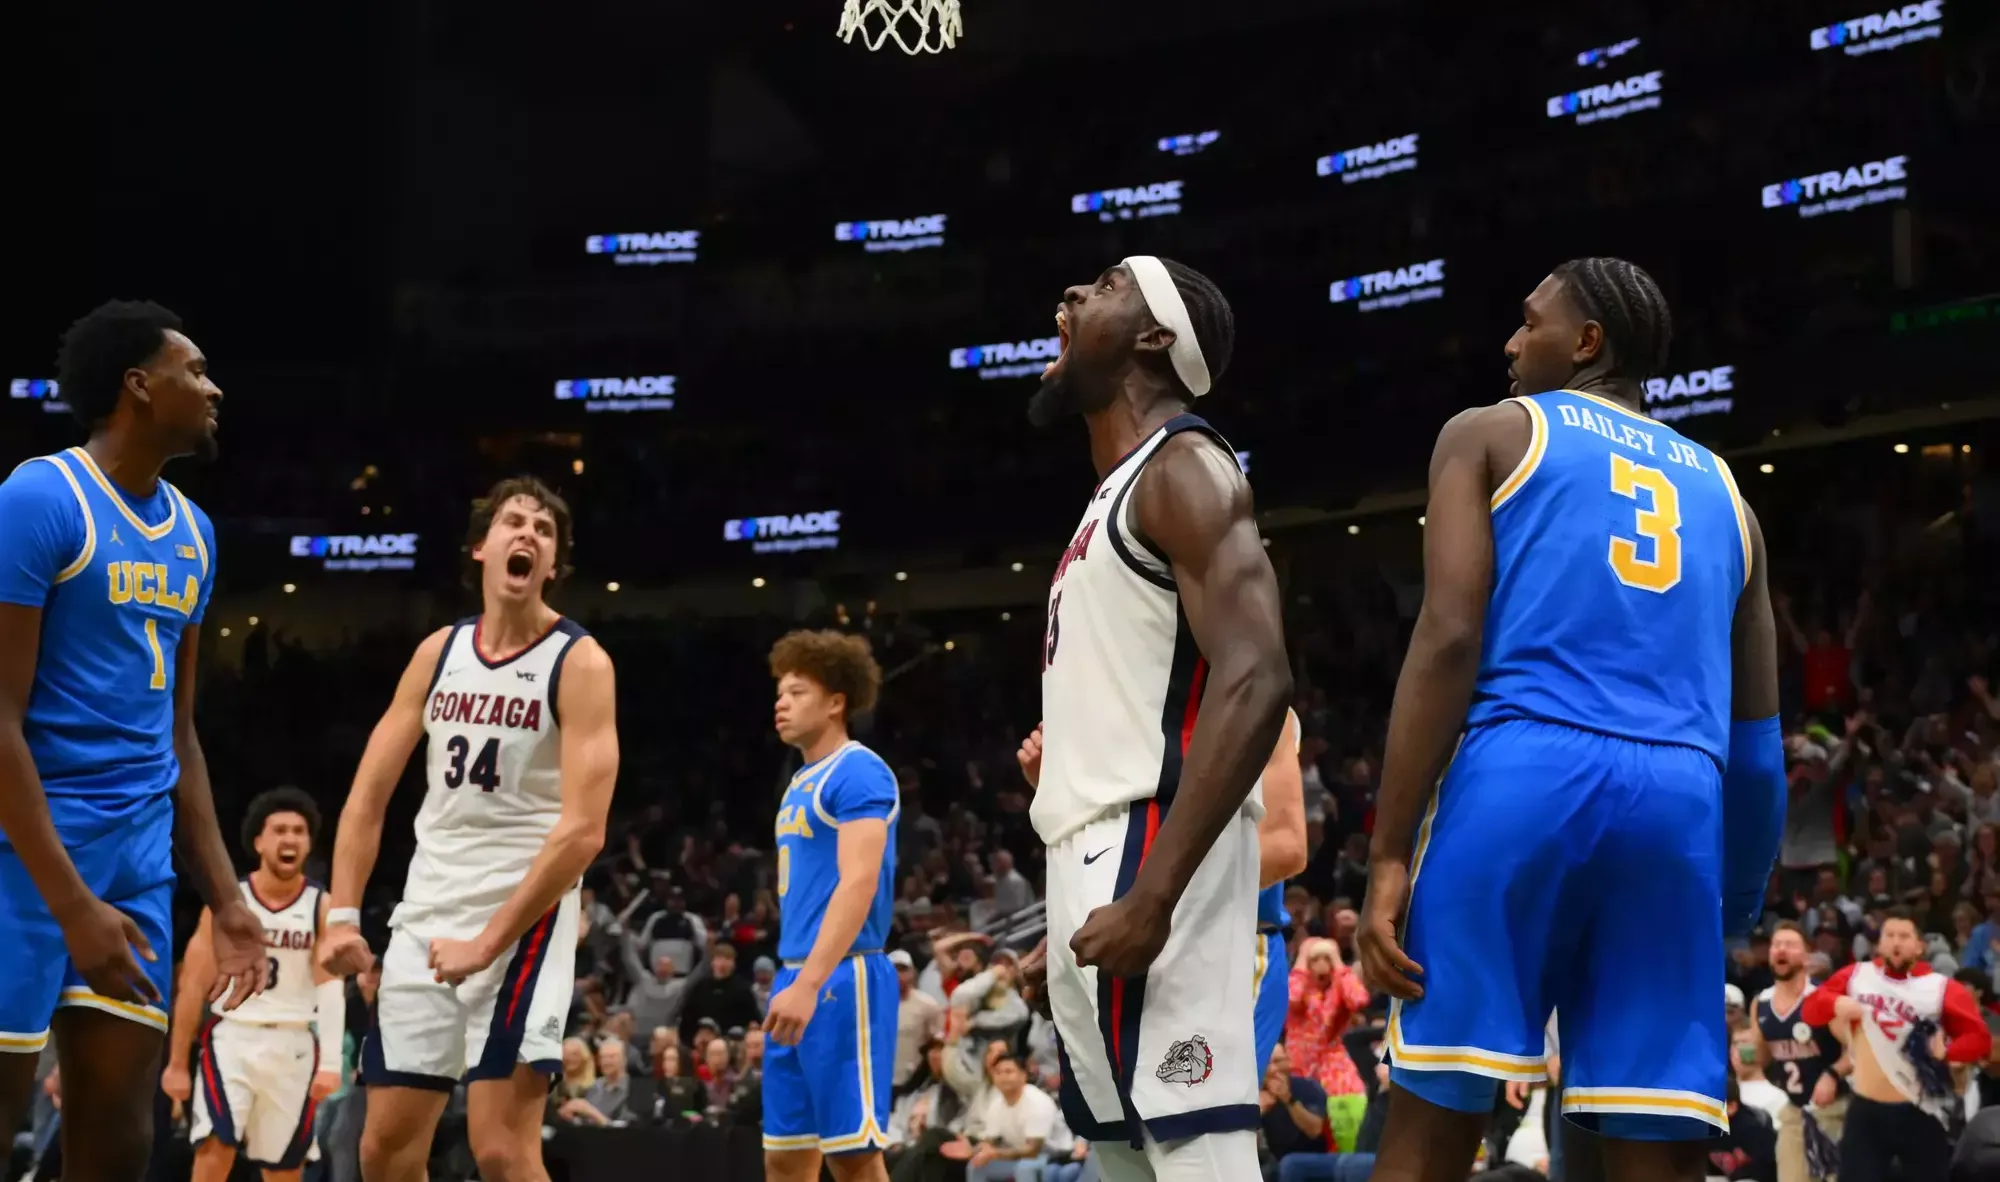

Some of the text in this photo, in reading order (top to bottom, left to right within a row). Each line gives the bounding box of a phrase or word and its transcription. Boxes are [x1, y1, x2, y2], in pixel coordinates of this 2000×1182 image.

[1643, 365, 1735, 403] RADE
[1557, 404, 1656, 456] DAILEY
[1667, 440, 1709, 473] JR.
[1608, 451, 1682, 594] 3
[107, 560, 200, 618] UCLA
[144, 617, 167, 690] 1
[430, 690, 542, 732] GONZAGA
[444, 734, 501, 793] 34
[1783, 1061, 1804, 1095] 2
